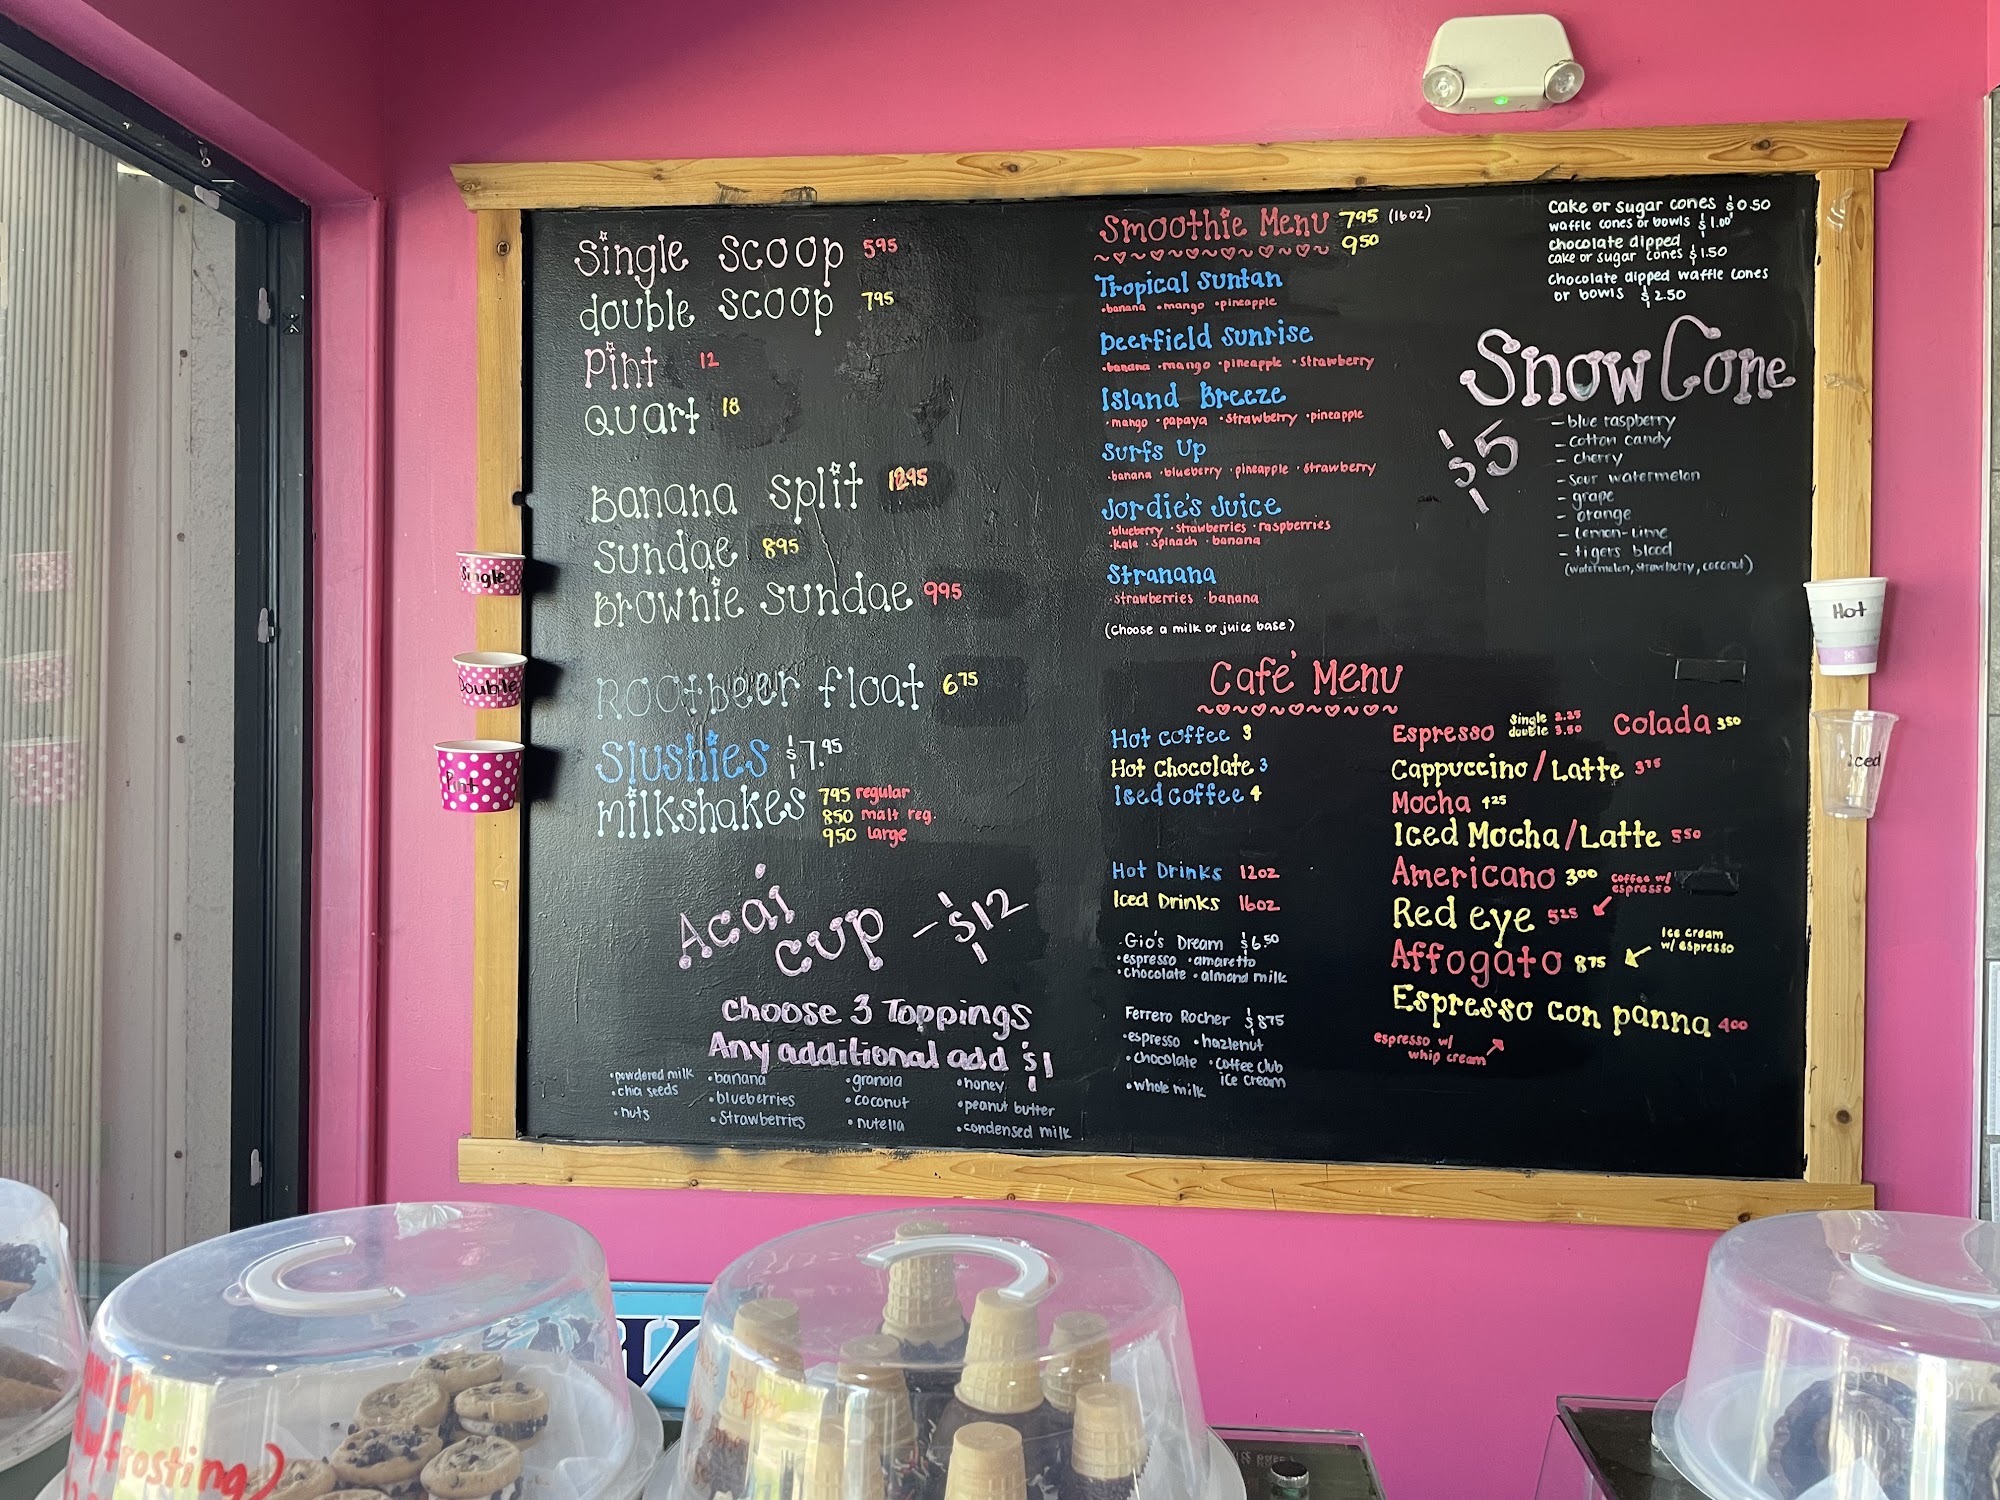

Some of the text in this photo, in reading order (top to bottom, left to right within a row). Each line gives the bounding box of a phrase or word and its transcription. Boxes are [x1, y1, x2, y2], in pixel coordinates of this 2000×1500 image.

[1591, 194, 1772, 218] or sugar $0.50
[1098, 206, 1330, 244] Smoothie Menu
[1548, 214, 1691, 233] waffle bowls
[1629, 234, 1680, 250] dipped
[1596, 243, 1728, 269] sugar $1.50
[1094, 271, 1189, 304] Tropical
[1624, 268, 1724, 287] dipped waffle
[1100, 296, 1278, 316] banana mango pineapple
[1578, 284, 1687, 309] bowls $2.50
[579, 288, 696, 337] double
[584, 340, 720, 391] Pint 12
[1161, 353, 1375, 376] mango pineapple strawberry
[1459, 314, 1797, 407] Snow Cone
[1101, 380, 1287, 412] Island Breeze
[722, 396, 741, 418] 18
[1111, 408, 1365, 434] mango papaya strawberry pineapple
[1567, 413, 1677, 433] blue raspberry
[1624, 430, 1672, 449] candy
[1175, 438, 1207, 464] Up
[1573, 450, 1624, 467] cherry
[1163, 460, 1377, 481] blueberry strawberry
[1437, 418, 1519, 514] $5
[1608, 469, 1701, 484] watermelon
[1100, 492, 1203, 522] Jordie's
[1571, 490, 1615, 512] grape
[1576, 508, 1632, 526] orange
[1111, 519, 1332, 539] blueberry strawberries raspberries
[1632, 540, 1673, 557] blood
[1106, 563, 1217, 586] Stranana
[1113, 591, 1194, 606] strawberries
[1833, 601, 1867, 618] Hot
[1204, 623, 1218, 634] or
[1219, 621, 1252, 636] juice
[817, 662, 925, 711] float
[1312, 658, 1404, 696] Menu
[1509, 710, 1548, 729] single
[1613, 703, 1712, 736] Colada
[1110, 726, 1152, 749] Hot
[1242, 723, 1252, 741] 3
[1392, 723, 1495, 753] Espresso
[1508, 723, 1550, 738] double
[1110, 752, 1255, 779] Hot Chocolate
[855, 783, 911, 806] regular
[1249, 784, 1263, 802] 4
[1391, 788, 1472, 816] Mocha
[597, 783, 807, 840] milkshakes
[861, 807, 937, 826] malt reg.
[867, 825, 908, 849] large
[1112, 859, 1281, 882] Hot Drinks 12oz
[1391, 854, 1556, 890] Americano
[1157, 892, 1221, 912] Drinks
[1392, 894, 1536, 950] Red eye
[1661, 926, 1681, 939] Ice
[773, 906, 884, 977] cup
[1124, 929, 1165, 950] Gio's
[1176, 934, 1224, 951] Dream
[1122, 953, 1177, 969] espresso
[1390, 938, 1563, 989] Affogato
[1200, 969, 1249, 984] almond
[849, 993, 873, 1025] 3
[1180, 1009, 1232, 1027] Rocher
[1392, 983, 1712, 1038] Espresso con panna
[1127, 1031, 1181, 1048] espresso
[707, 1030, 771, 1075] Any
[777, 1036, 940, 1070] additional
[946, 1036, 1010, 1072] add
[1407, 1048, 1441, 1066] whip
[614, 1067, 695, 1085] powdered milk
[713, 1071, 767, 1086] banana
[851, 1073, 903, 1093] granola
[963, 1076, 1005, 1094] honey
[1133, 1077, 1170, 1094] whole
[617, 1082, 679, 1098] chia seeds
[716, 1090, 796, 1108] blueberries
[854, 1094, 911, 1110] coconut
[964, 1099, 1056, 1117] peanut butter
[620, 1105, 651, 1122] nuts
[856, 1117, 905, 1132] nutella
[963, 1120, 1073, 1141] condensed milk
